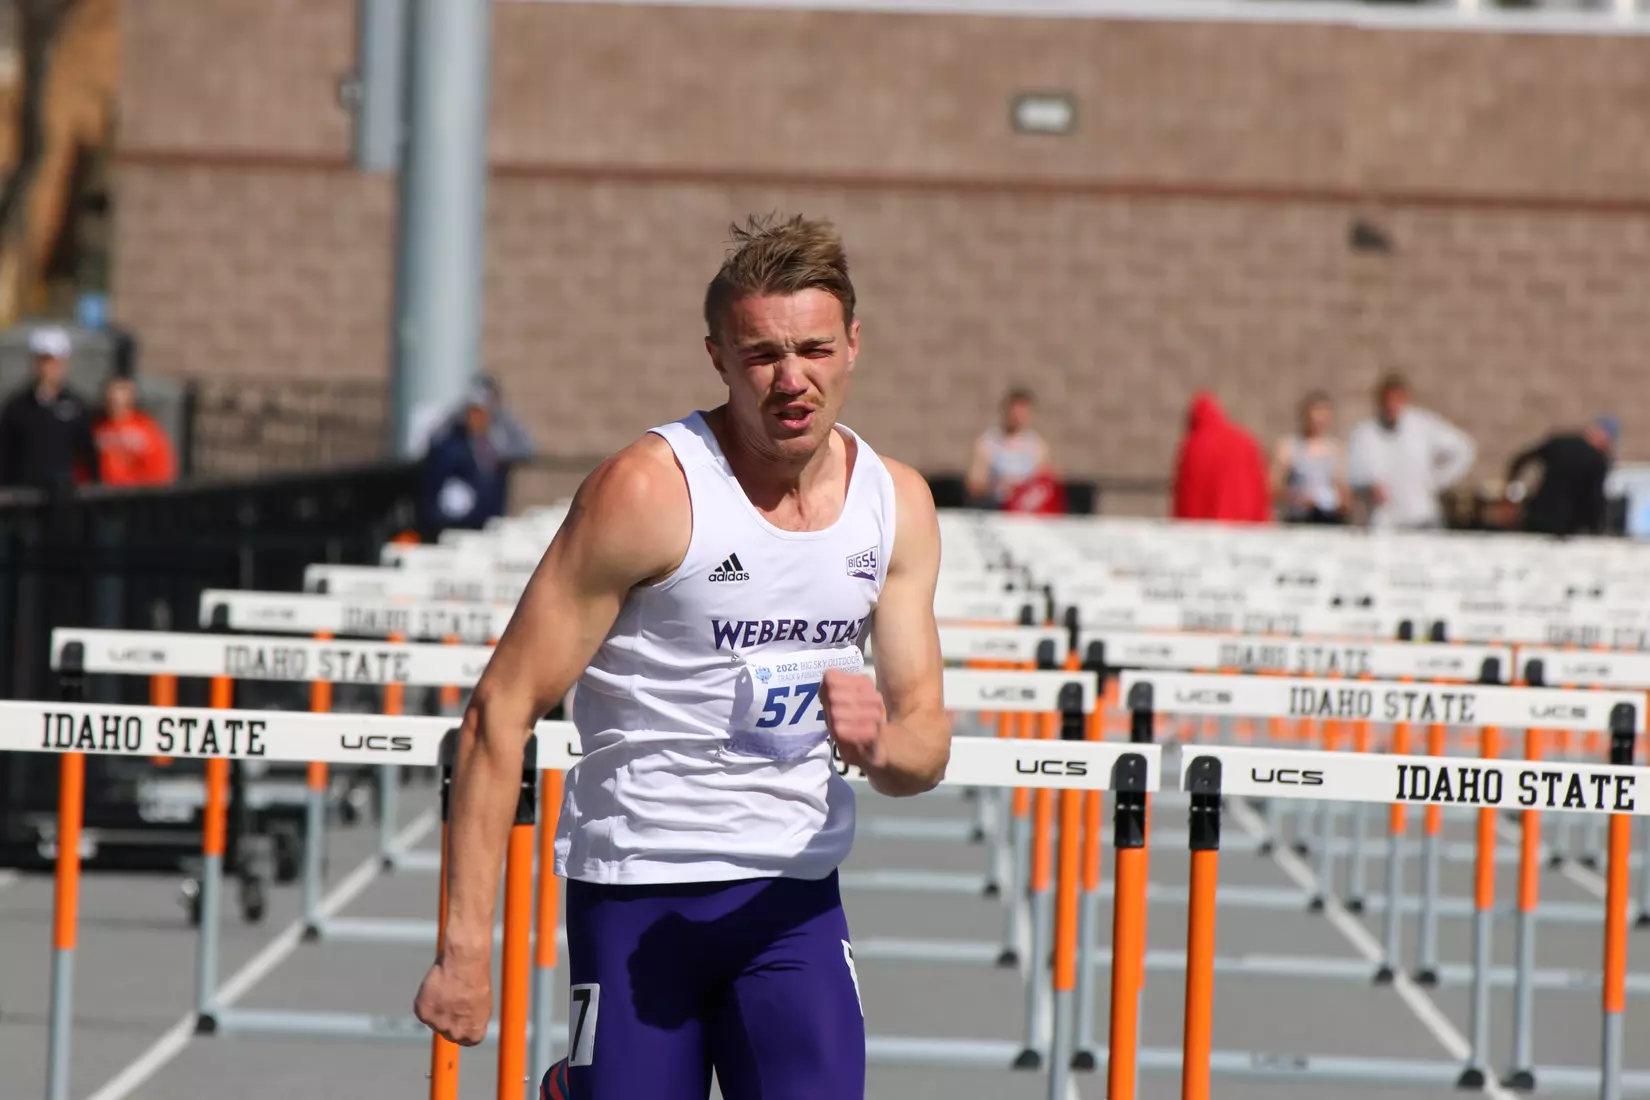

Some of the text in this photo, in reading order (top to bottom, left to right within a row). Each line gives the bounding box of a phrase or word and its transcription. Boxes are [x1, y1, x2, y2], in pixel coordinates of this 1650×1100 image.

[708, 571, 750, 582] adidas
[711, 619, 866, 651] WEBER STAT
[225, 645, 308, 678] IDAHO
[318, 649, 411, 682] STATE
[776, 655, 860, 673] 2022 BIG SKY OUTDOOR
[756, 682, 825, 728] 57
[1289, 687, 1373, 719] IDAHO
[1384, 692, 1476, 723] STATE
[41, 712, 412, 757] IDAHO STATE UCS
[1016, 759, 1088, 776] UCS
[1251, 764, 1636, 812] UCS IDAHO STATE
[570, 988, 592, 1062] 7
